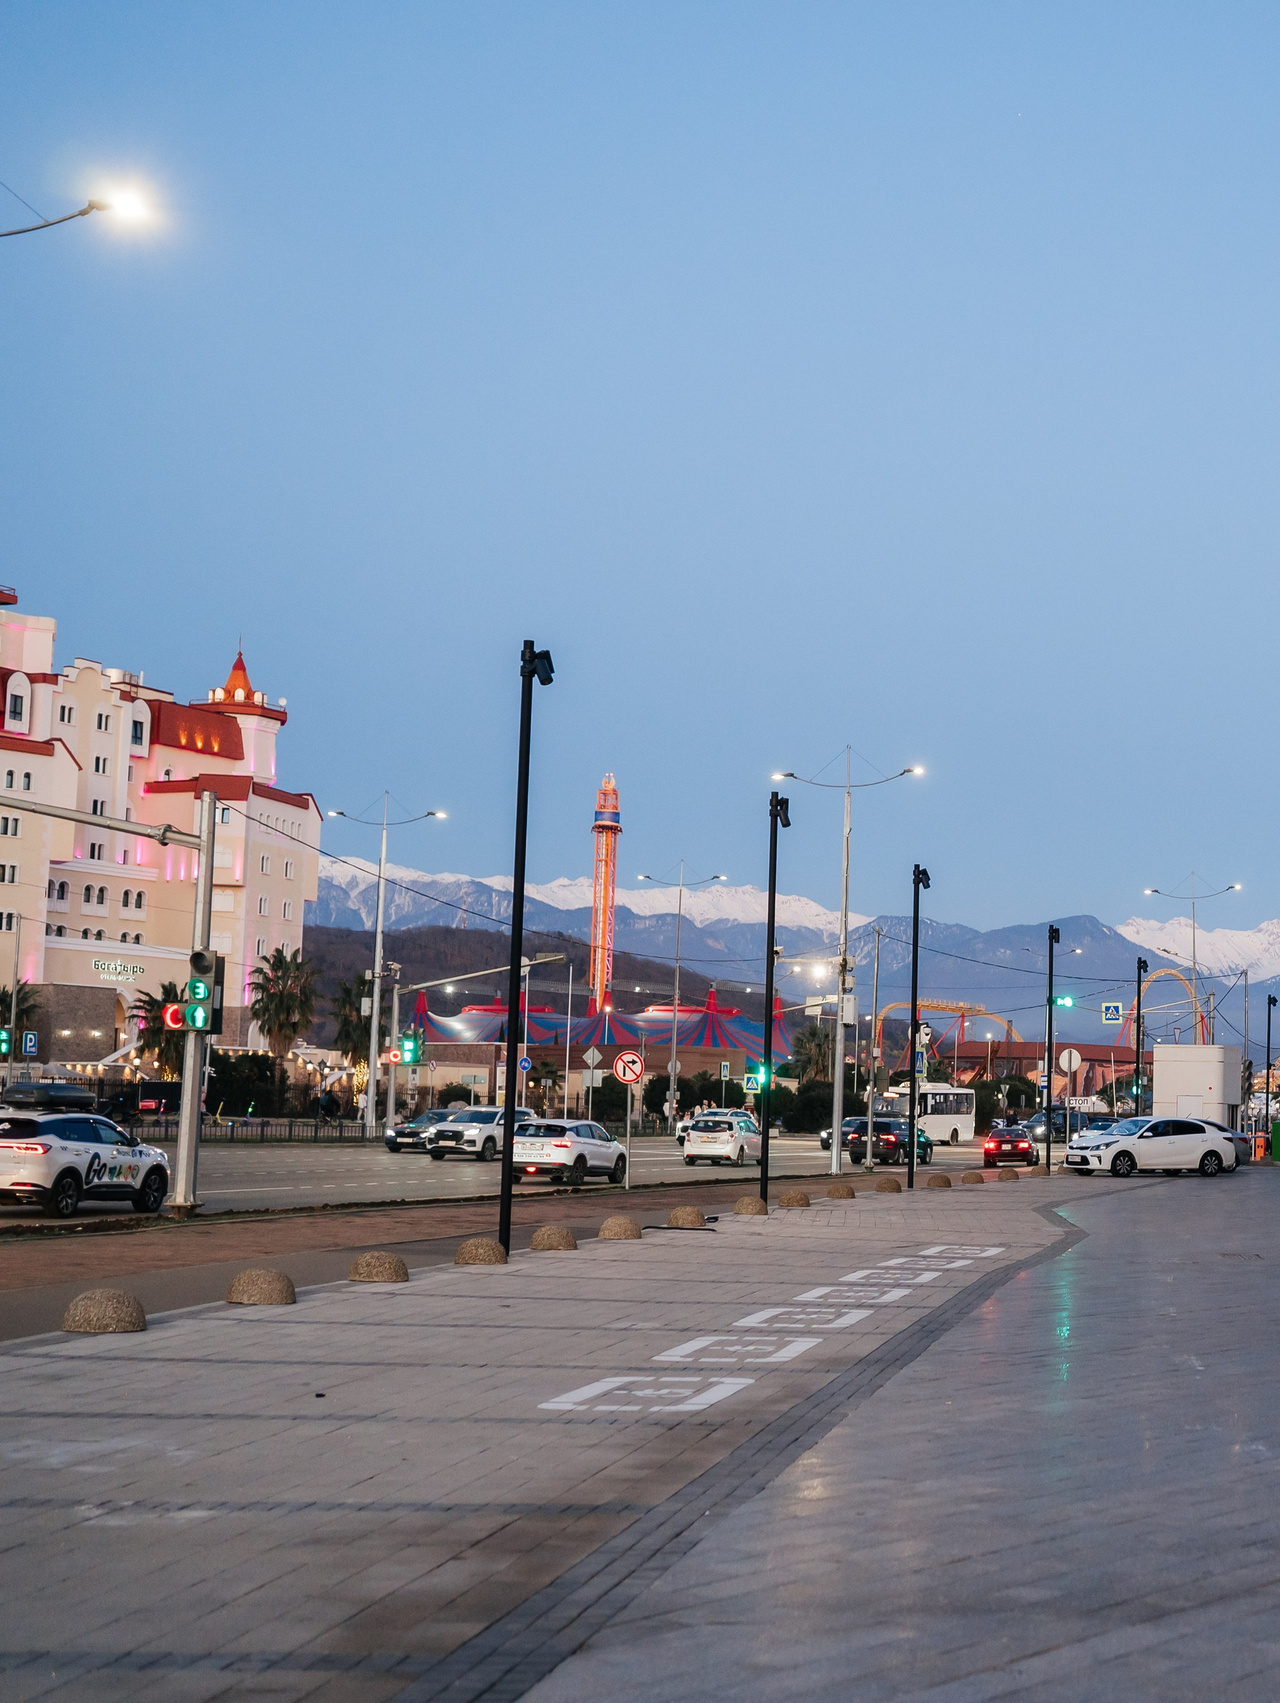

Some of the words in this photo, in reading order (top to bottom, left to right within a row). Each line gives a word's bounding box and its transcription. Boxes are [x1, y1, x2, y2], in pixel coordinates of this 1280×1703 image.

[93, 959, 145, 974] Богатырь
[194, 982, 205, 999] 3
[26, 1034, 35, 1052] P
[85, 1152, 107, 1186] Go
